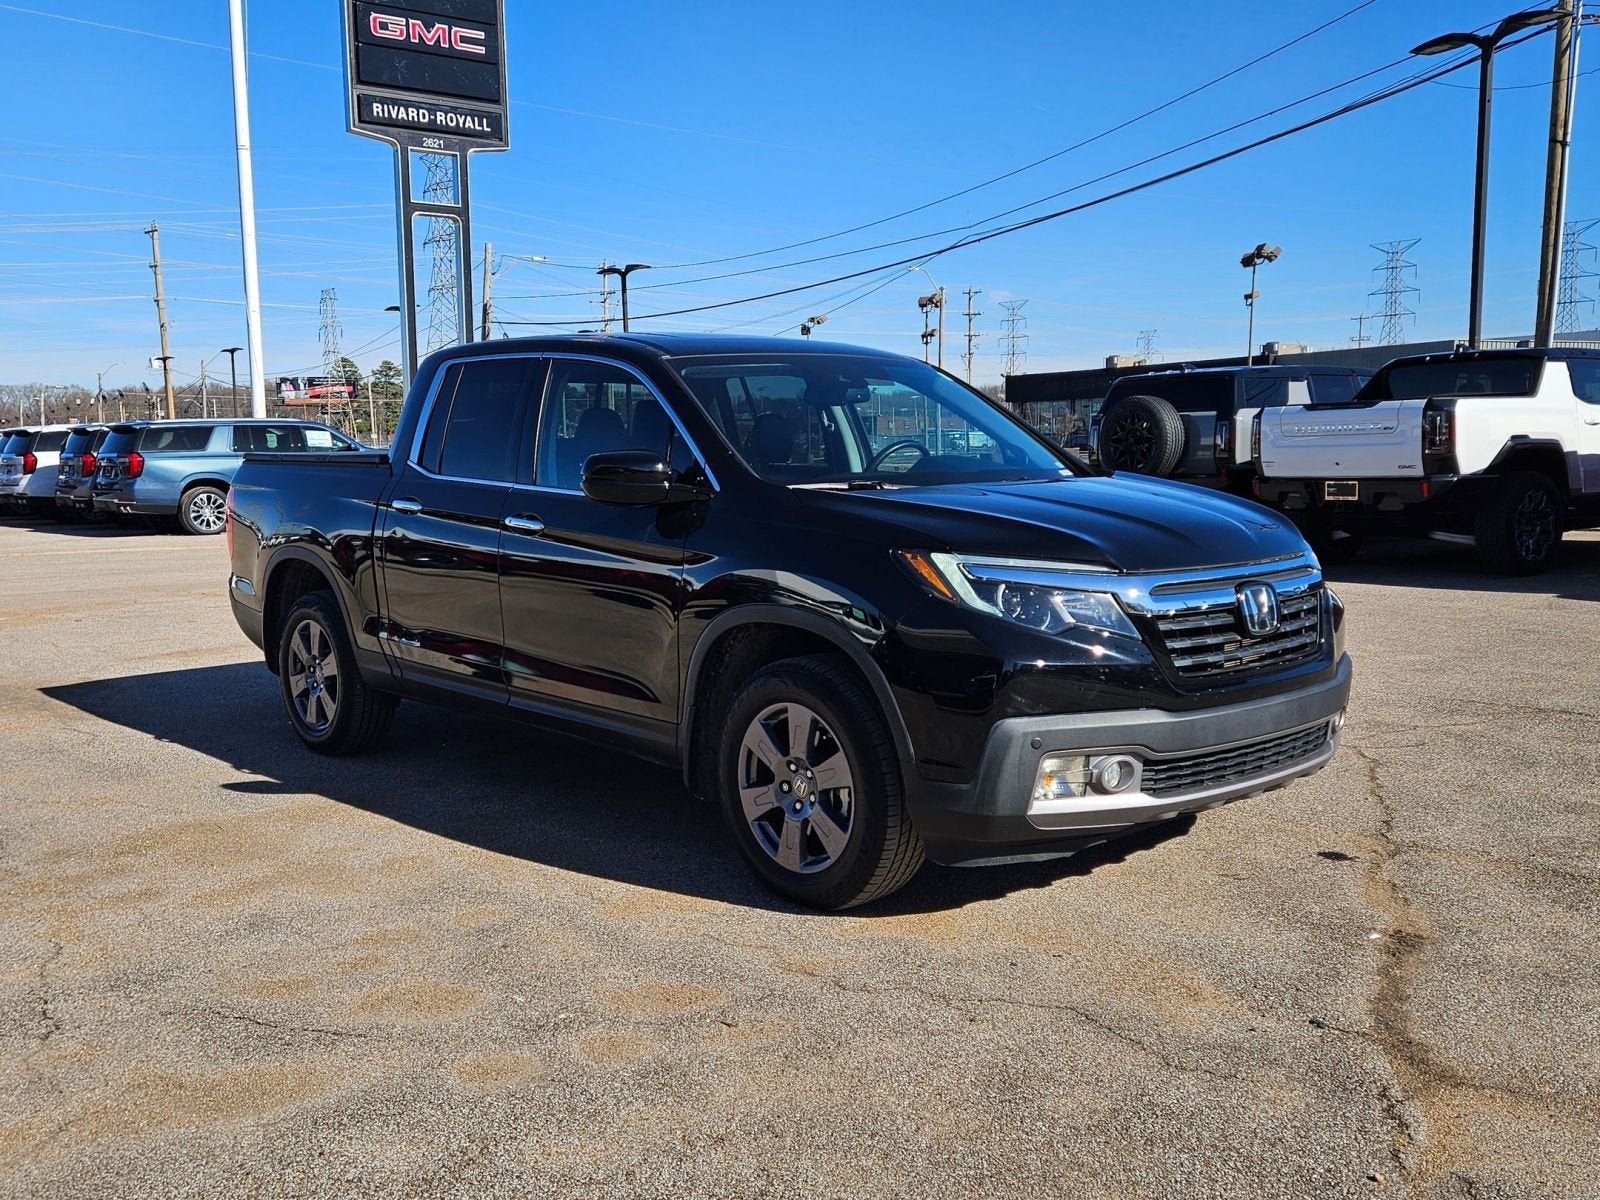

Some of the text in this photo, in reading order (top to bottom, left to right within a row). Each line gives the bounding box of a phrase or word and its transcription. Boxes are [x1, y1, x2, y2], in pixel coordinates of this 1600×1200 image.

[370, 12, 486, 55] GMC
[372, 103, 491, 131] RIVARD-ROYALL
[422, 137, 444, 149] 2621
